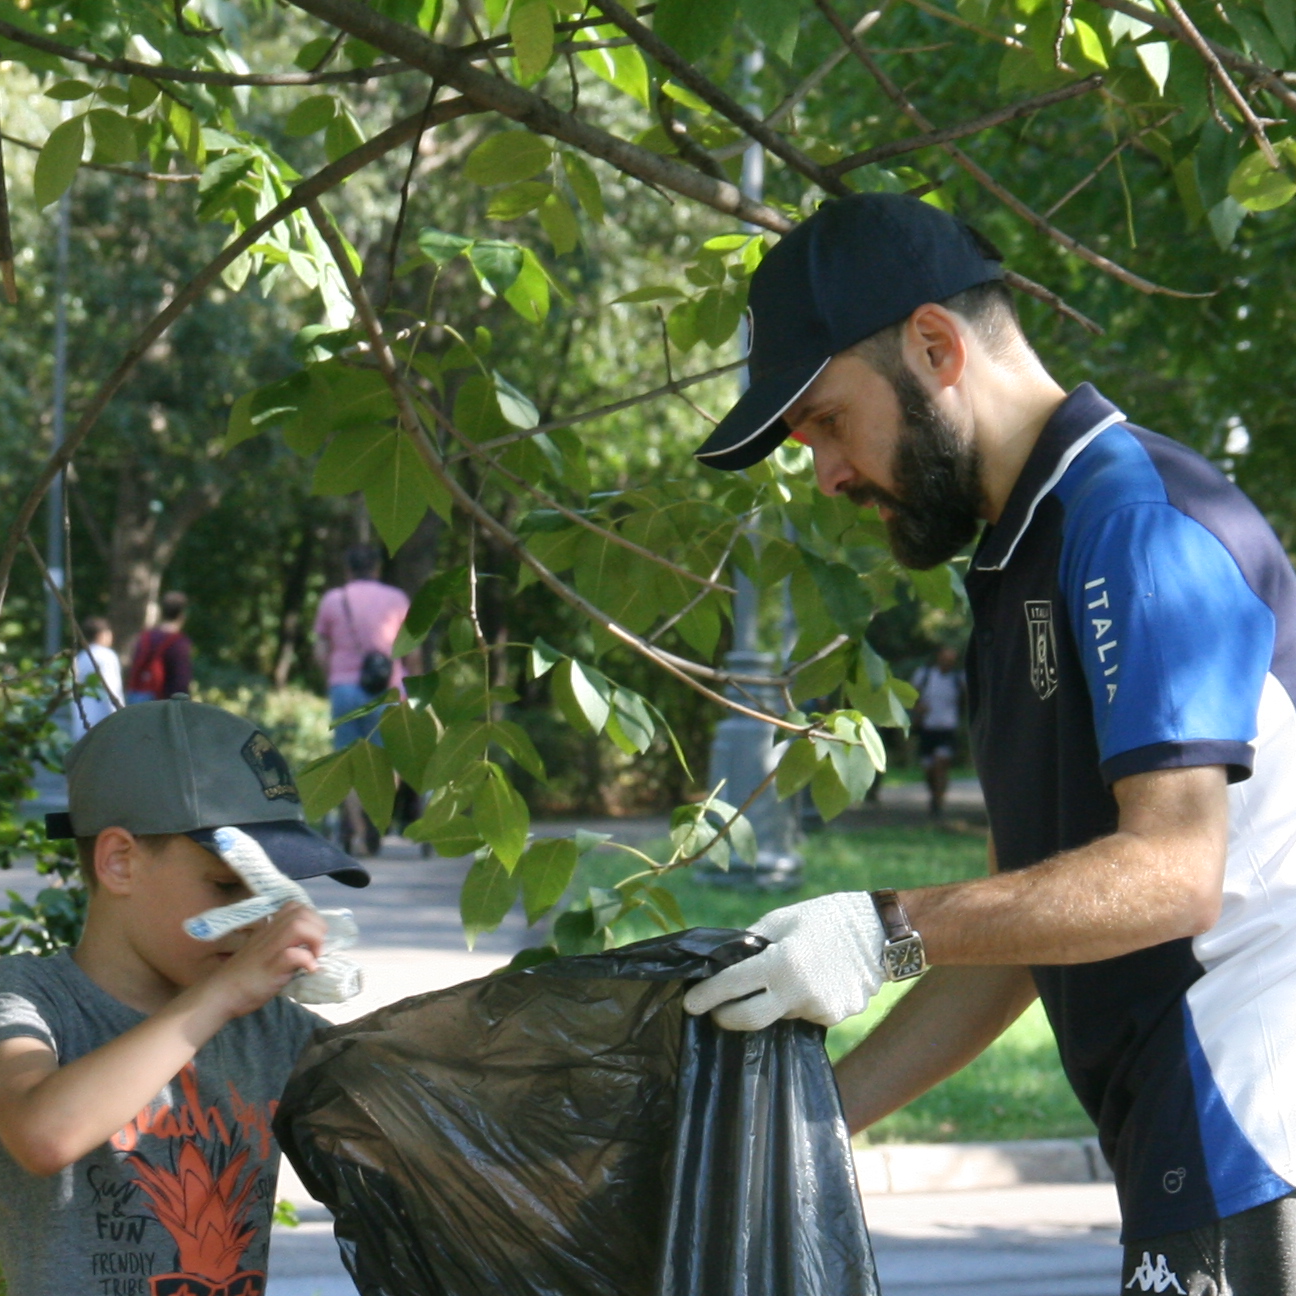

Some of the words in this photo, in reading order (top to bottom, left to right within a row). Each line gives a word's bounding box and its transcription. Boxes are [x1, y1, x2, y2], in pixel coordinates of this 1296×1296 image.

[1084, 576, 1119, 704] ITALIA
[112, 1201, 125, 1218] &
[96, 1212, 148, 1245] FUN
